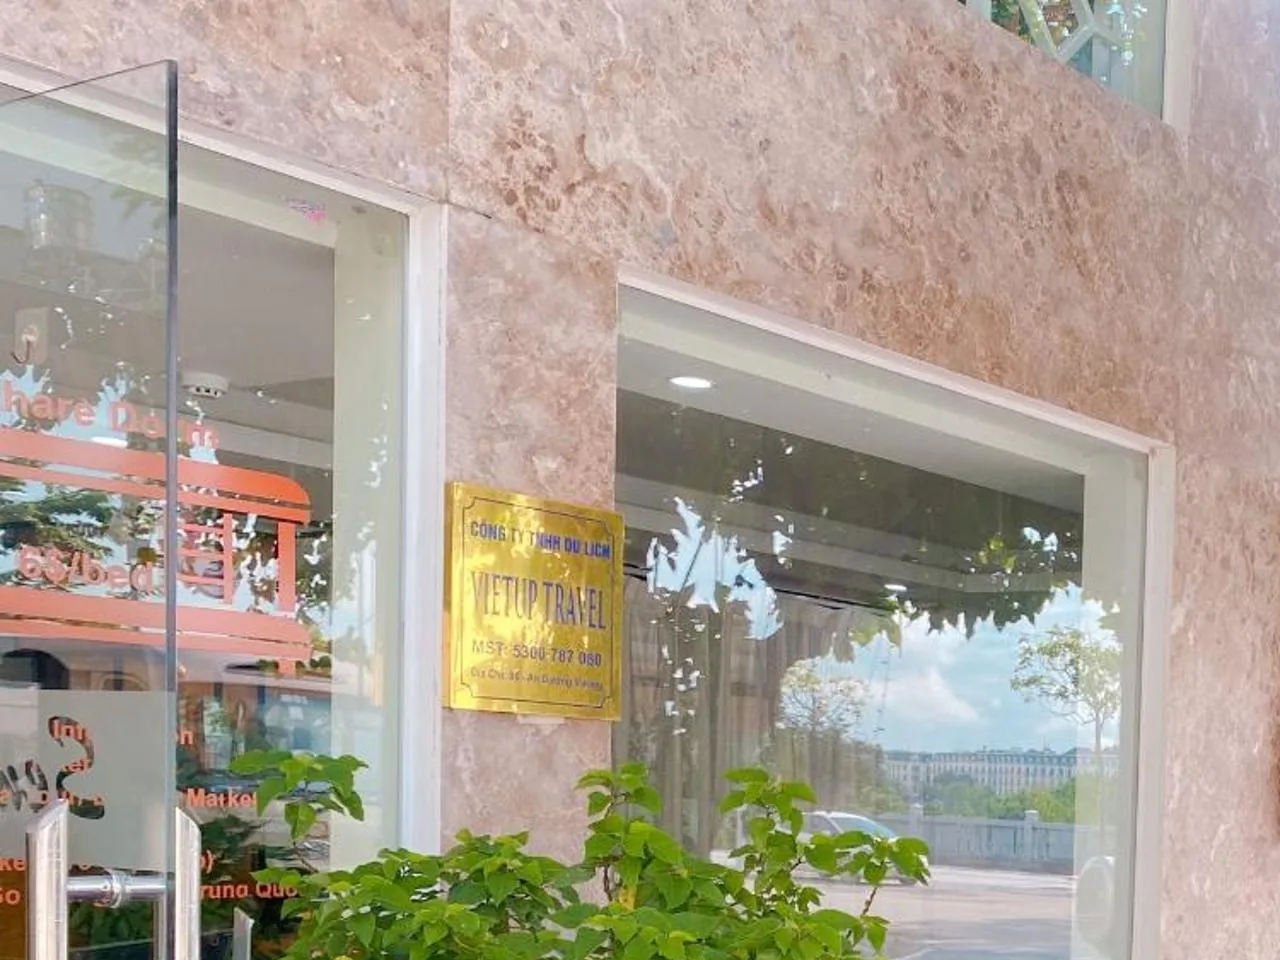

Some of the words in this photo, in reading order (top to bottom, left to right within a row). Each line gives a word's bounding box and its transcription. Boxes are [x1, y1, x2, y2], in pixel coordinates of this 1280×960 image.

[2, 380, 97, 428] hare
[471, 570, 539, 621] VIETUP
[542, 580, 607, 630] TRAVEL
